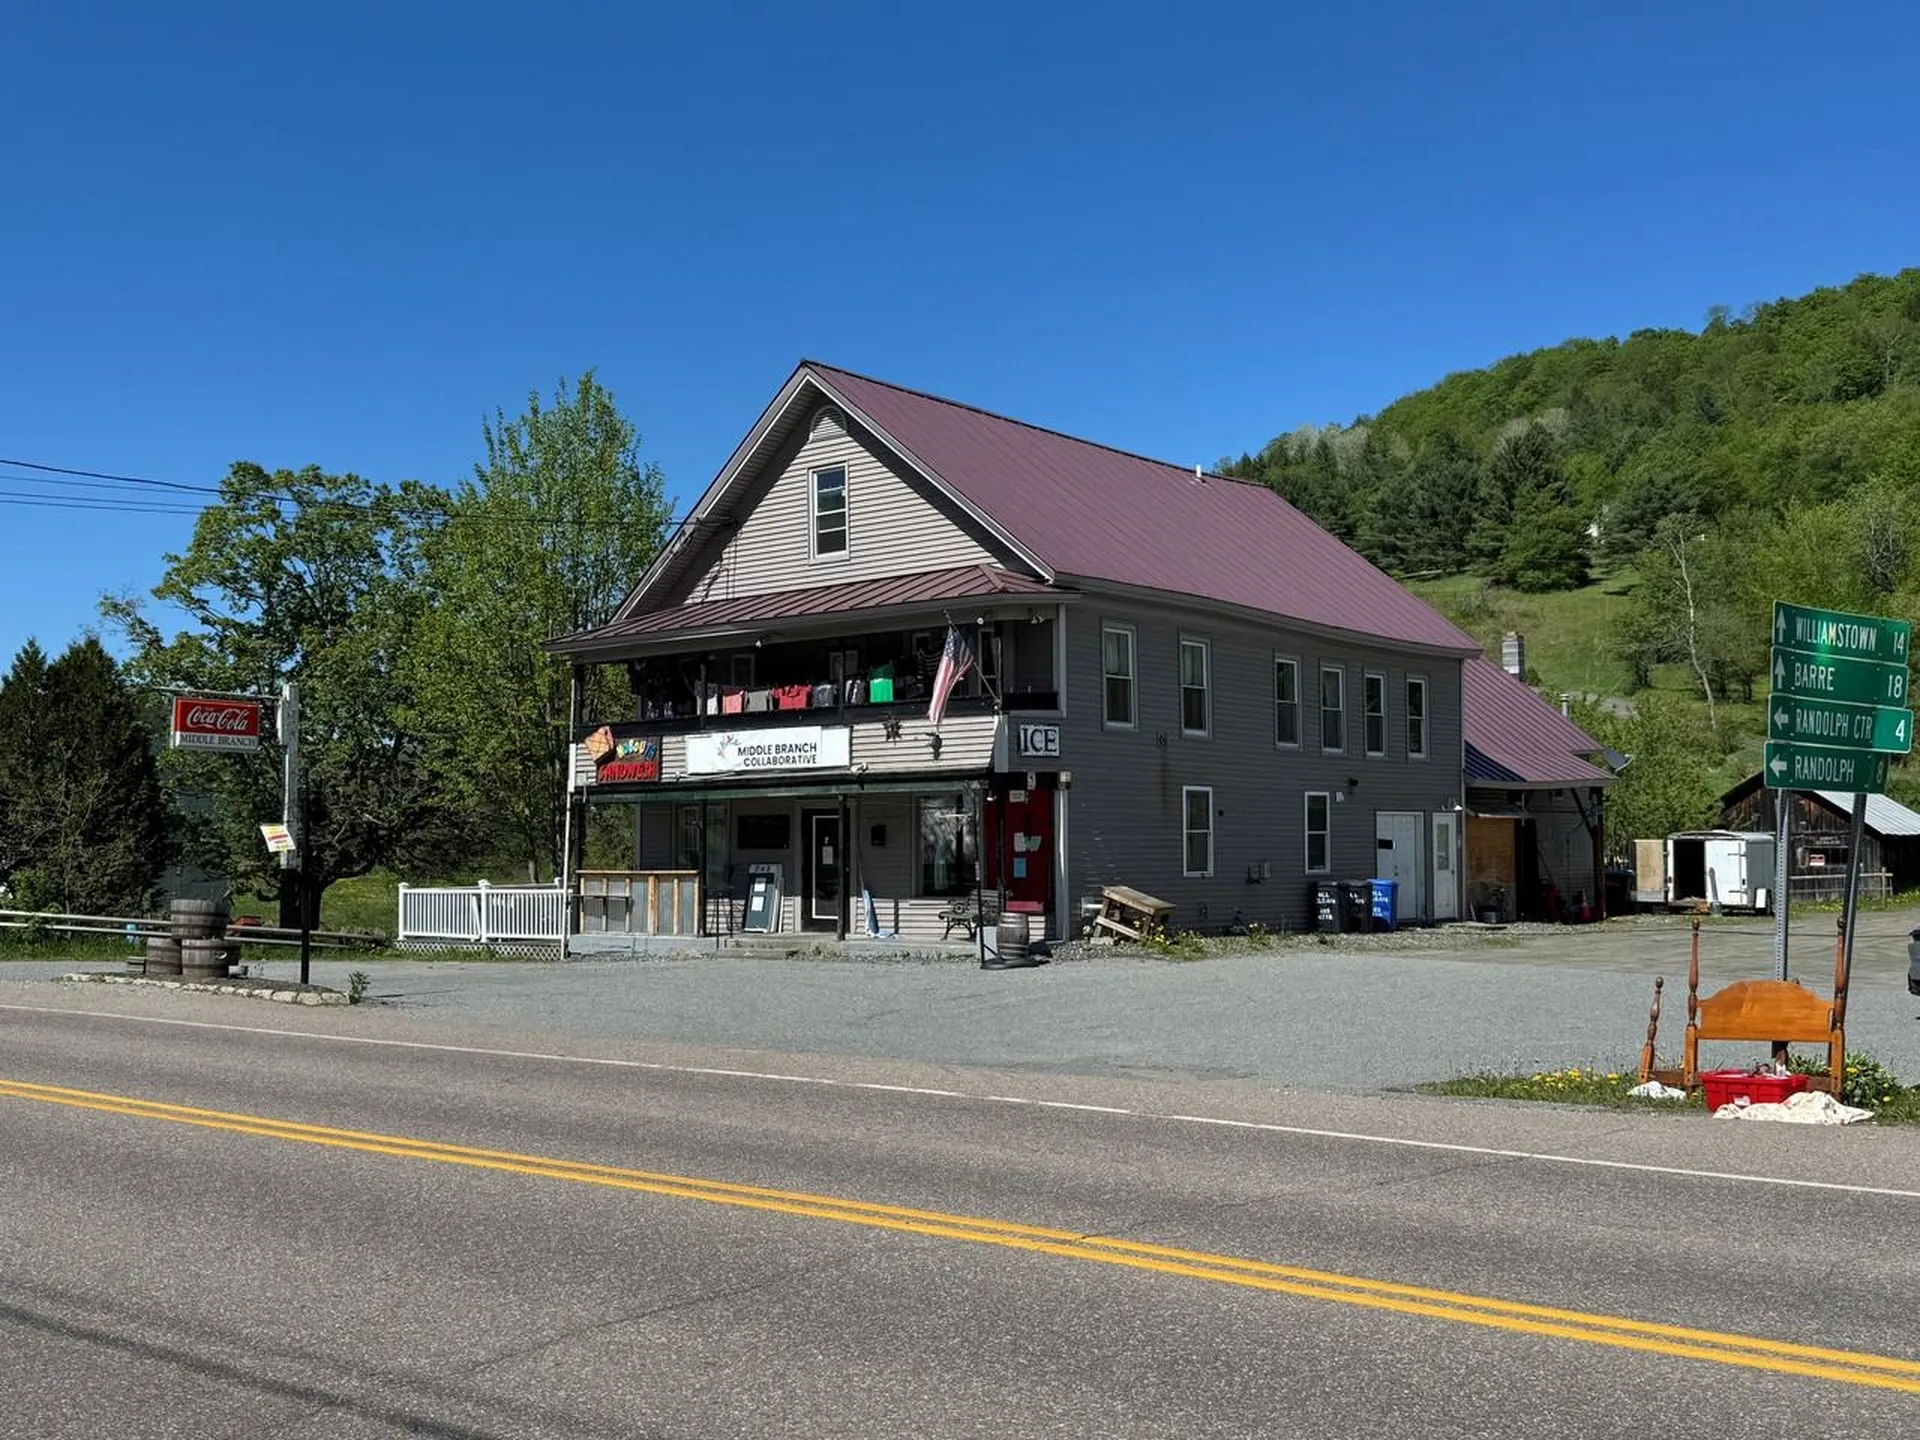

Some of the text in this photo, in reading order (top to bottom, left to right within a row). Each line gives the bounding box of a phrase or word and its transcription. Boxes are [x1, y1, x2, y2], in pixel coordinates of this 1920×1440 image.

[1795, 616, 1905, 655] WILLIAMSTOWN 14
[1794, 663, 1903, 698] BARRE 18
[1795, 709, 1905, 743] RANDOLPH CTR 4
[180, 733, 257, 747] MIDDLE BRANCH
[737, 742, 817, 757] MIDDLE BRANCH
[1021, 728, 1057, 752] ICE
[743, 754, 817, 767] COLLABORATIVE
[1794, 755, 1855, 783] RANDOLPH
